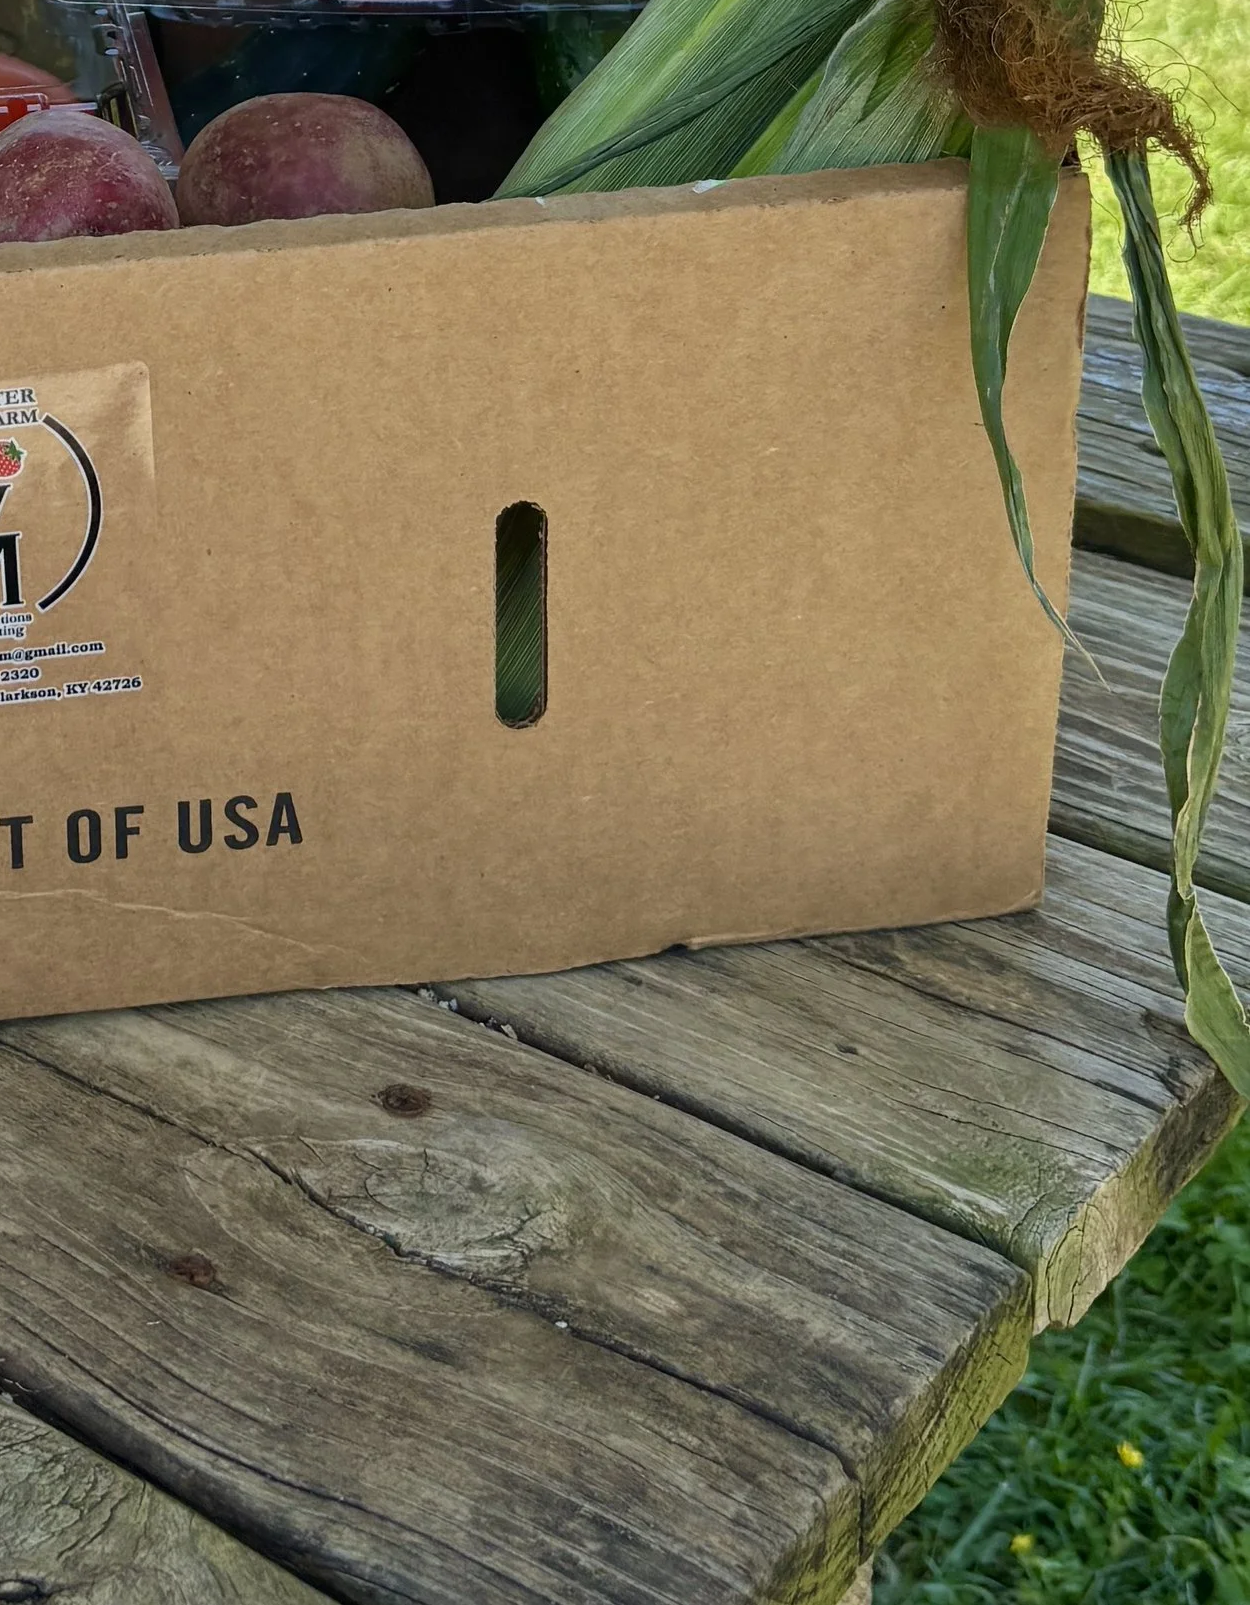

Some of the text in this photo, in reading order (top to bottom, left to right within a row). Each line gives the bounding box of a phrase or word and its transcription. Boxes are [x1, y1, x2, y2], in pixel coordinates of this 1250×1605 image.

[65, 682, 88, 696] KY
[92, 676, 142, 692] 42726
[66, 804, 145, 864] OF
[177, 792, 304, 854] USA
